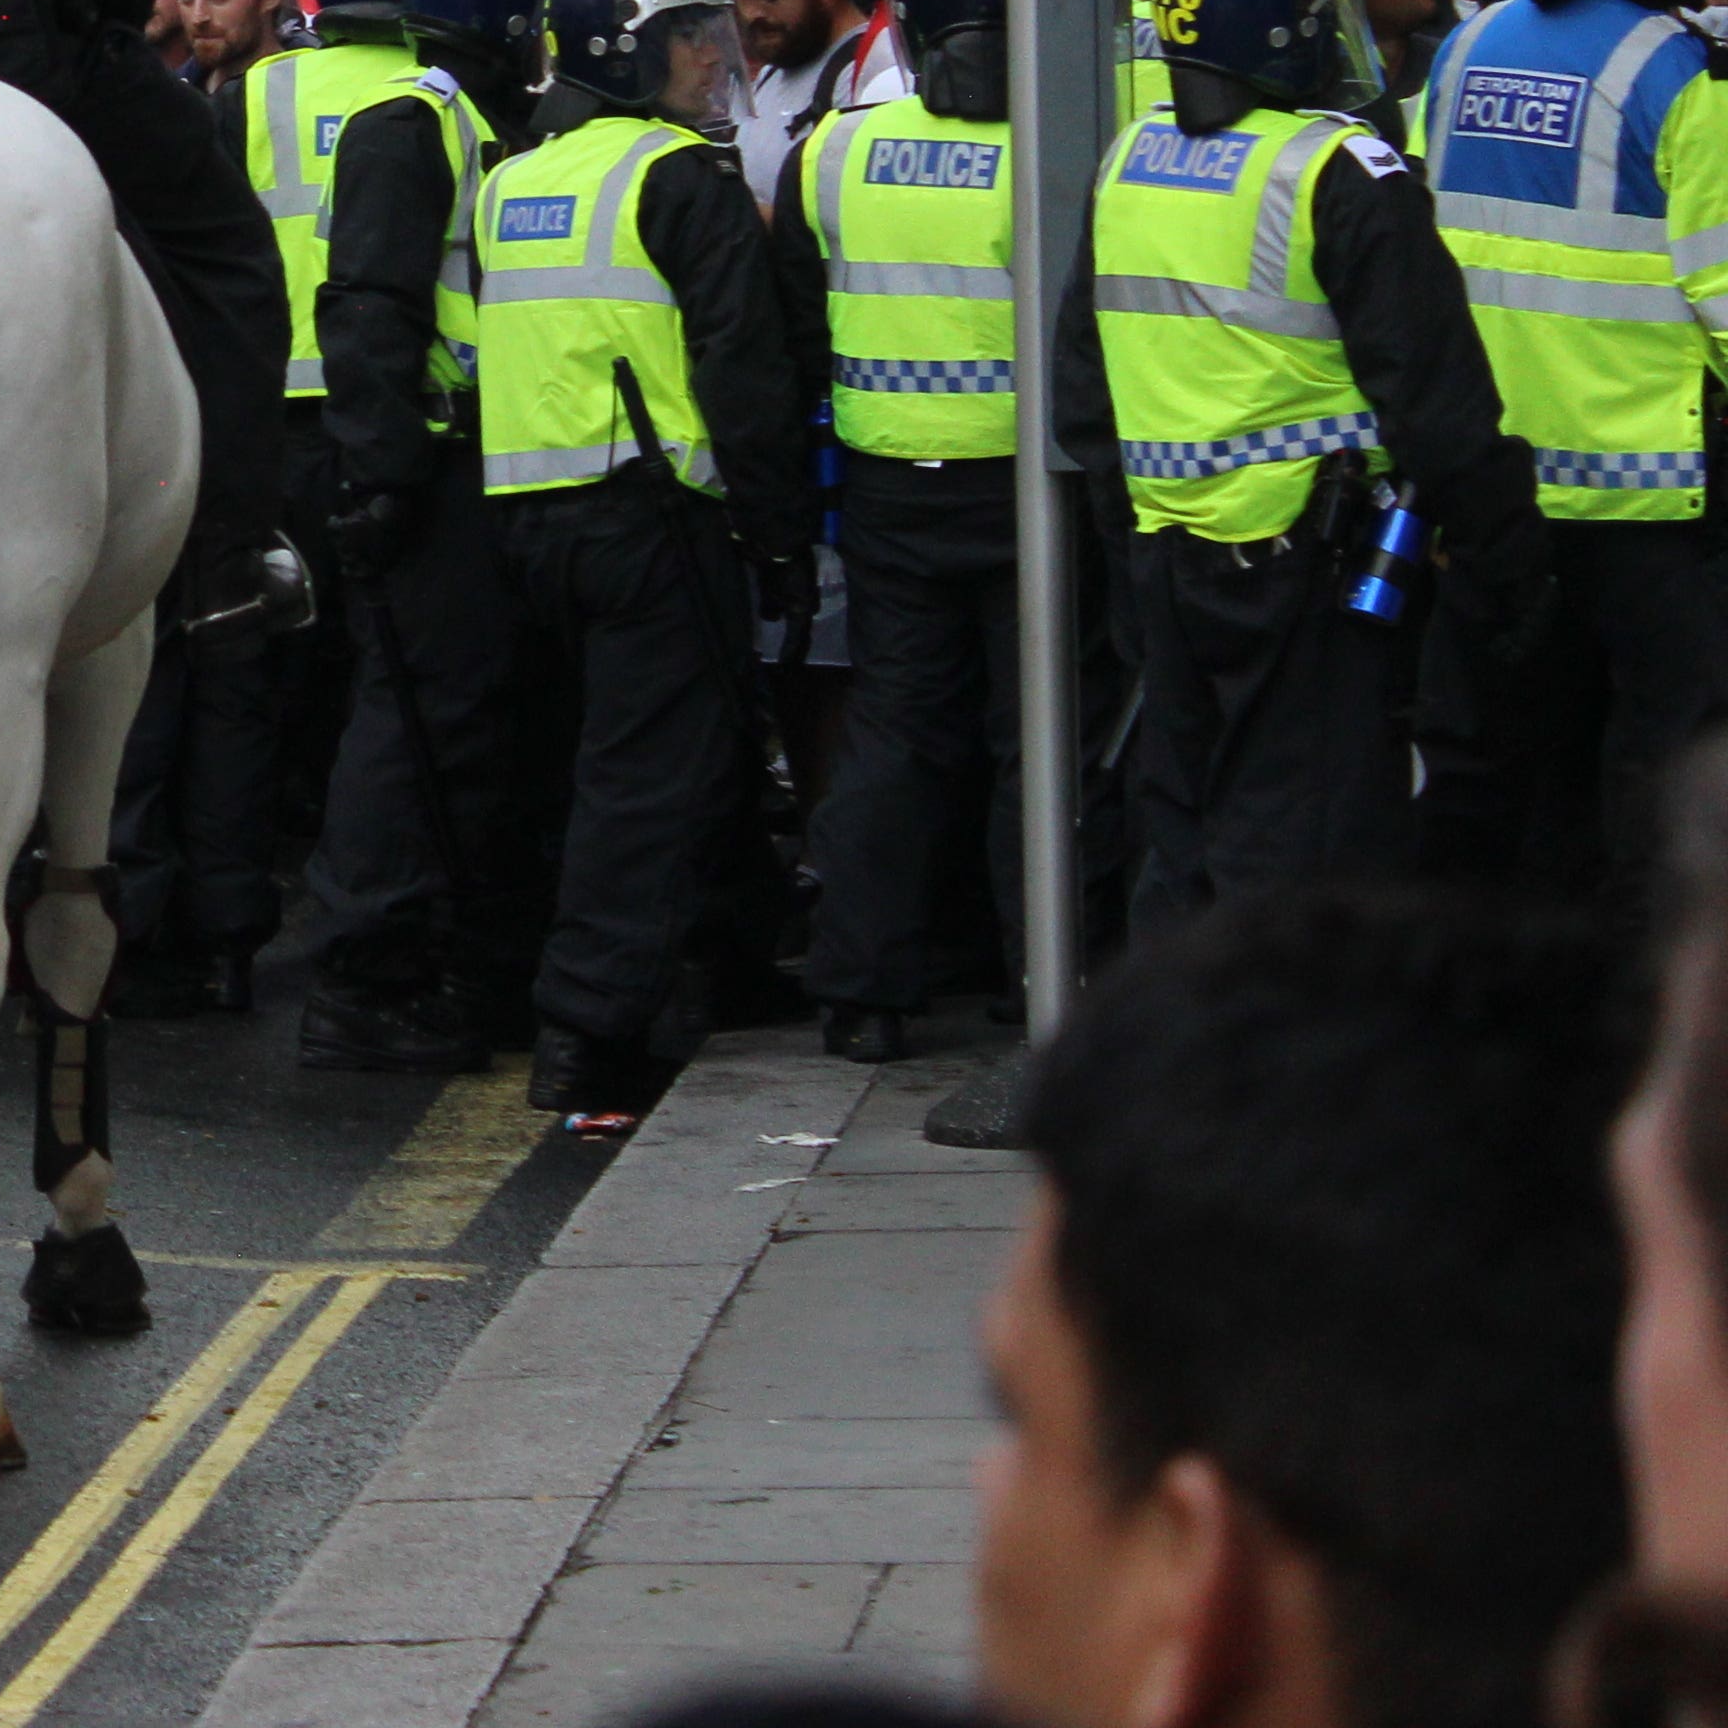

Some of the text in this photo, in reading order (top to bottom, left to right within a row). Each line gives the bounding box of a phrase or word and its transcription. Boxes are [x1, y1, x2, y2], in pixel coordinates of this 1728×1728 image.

[1458, 94, 1568, 136] POLICE
[870, 140, 998, 187] POLICE
[1129, 128, 1245, 181] POLICE
[500, 200, 571, 237] POLICE
